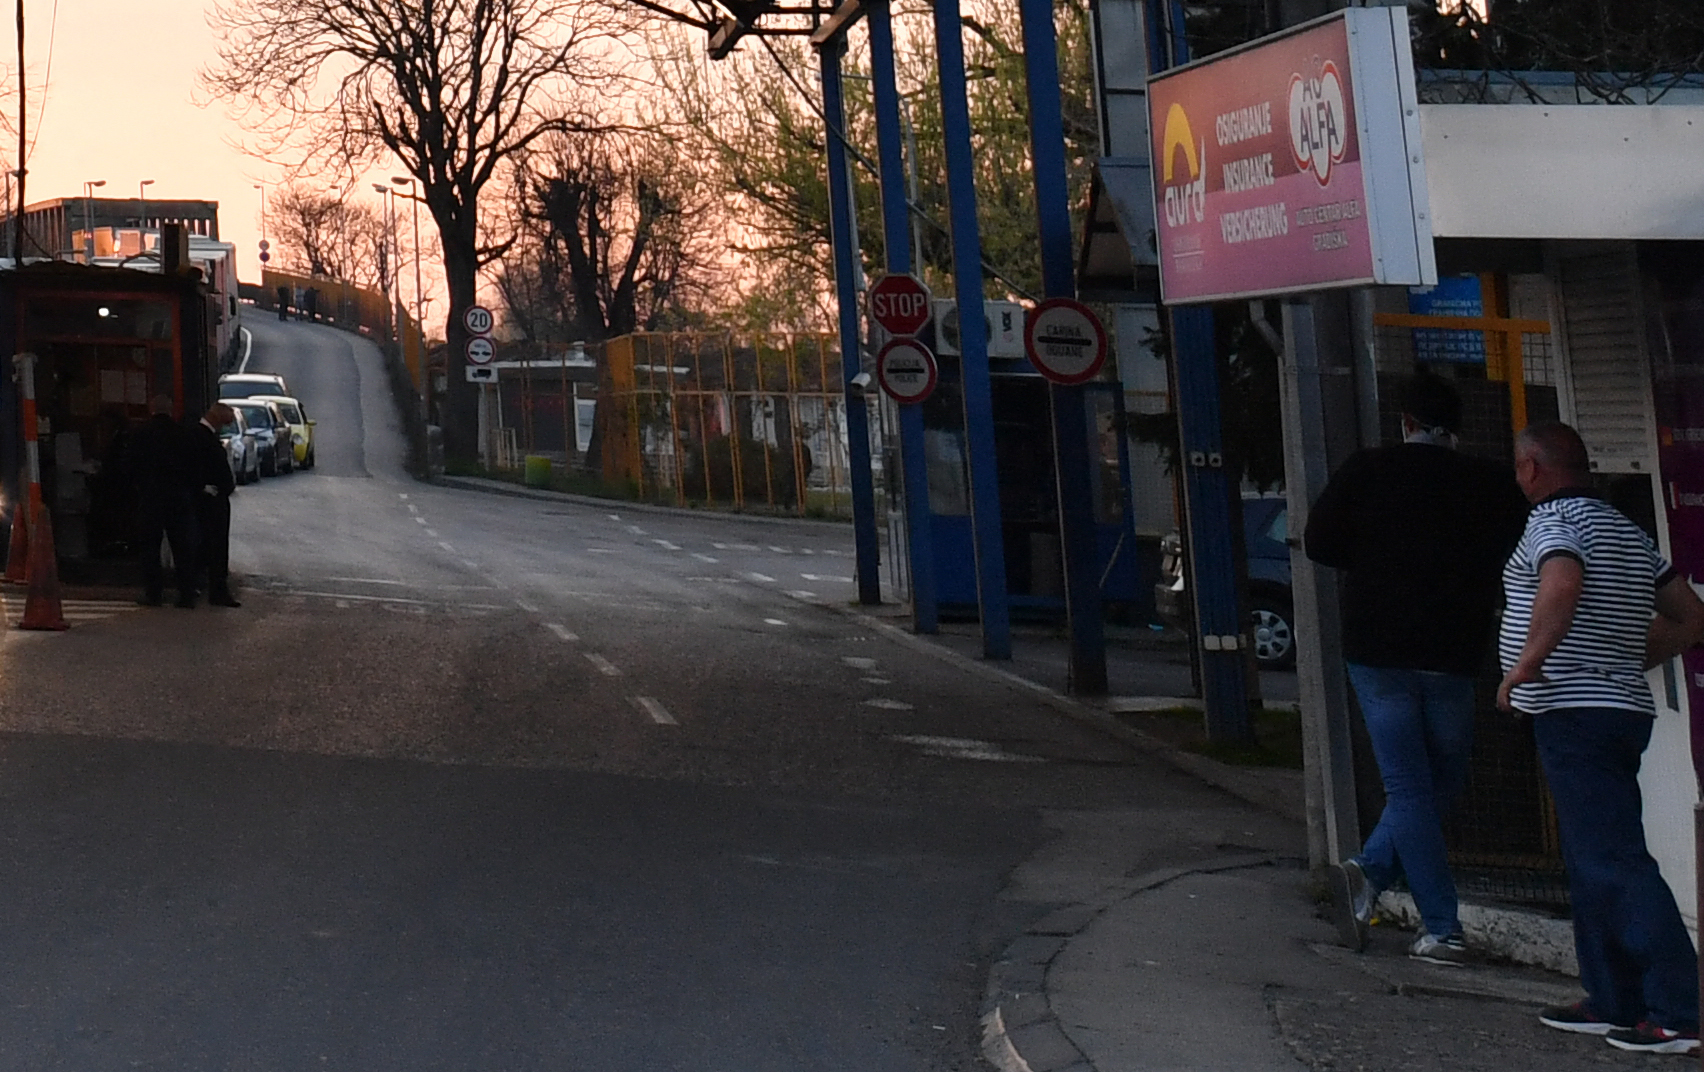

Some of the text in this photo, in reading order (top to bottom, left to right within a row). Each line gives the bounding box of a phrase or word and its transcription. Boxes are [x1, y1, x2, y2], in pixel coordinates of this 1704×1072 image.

[1215, 101, 1272, 146] OSIGURANJE
[1299, 99, 1339, 153] ALFA
[1222, 152, 1275, 193] INSURANCE
[1219, 202, 1289, 243] VERSICHERUNG
[470, 312, 488, 328] 20
[874, 293, 925, 317] STOP
